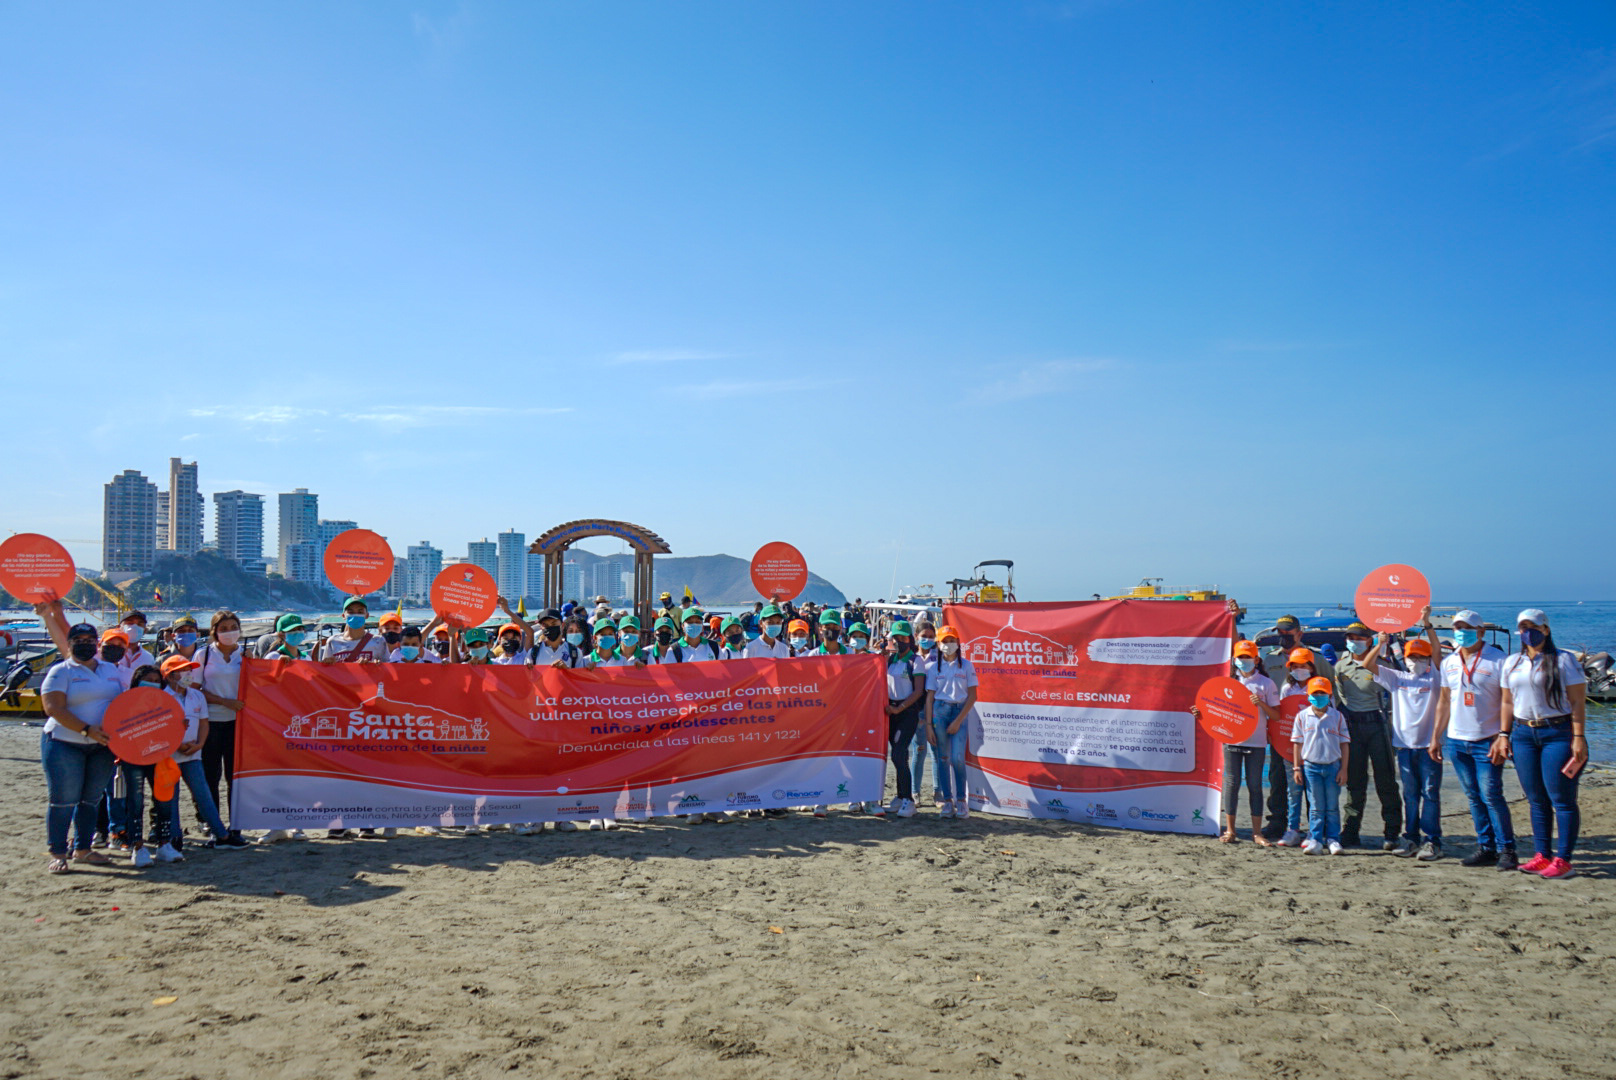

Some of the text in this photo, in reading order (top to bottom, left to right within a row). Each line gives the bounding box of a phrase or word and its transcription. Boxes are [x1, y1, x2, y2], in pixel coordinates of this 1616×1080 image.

[992, 639, 1043, 653] Santa
[991, 651, 1044, 665] Marta
[982, 666, 1028, 676] protectora
[1030, 668, 1040, 676] de
[1042, 668, 1051, 676] la
[1053, 668, 1076, 676] niñez
[535, 682, 820, 708] La explotación sexual comercial
[1021, 690, 1048, 700] ¿Qué
[1064, 691, 1074, 700] la
[1076, 692, 1131, 703] ESCNNA?
[528, 698, 827, 721] vulnera los derechos de las niñas,
[349, 711, 434, 727] Santa
[590, 714, 776, 734] niños y adolescentes
[992, 712, 1036, 720] explotación
[1120, 720, 1168, 728] intercambio
[347, 725, 435, 740] Marta
[1018, 722, 1037, 730] pago
[1125, 728, 1168, 736] utilización
[558, 730, 801, 754] ¡Denúnciala a las líneas 141 y 122!
[1008, 736, 1045, 745] integridad
[1120, 744, 1140, 752] paga
[1160, 746, 1186, 754] cárcel
[1071, 733, 1122, 742] adolescentes,
[1143, 738, 1184, 746] conducta
[286, 742, 486, 752] Bahía protectora de la niñez
[786, 790, 824, 798] Renacer
[306, 806, 373, 814] responsable
[1047, 806, 1070, 814] TURISMO
[1142, 811, 1178, 820] Renacer
